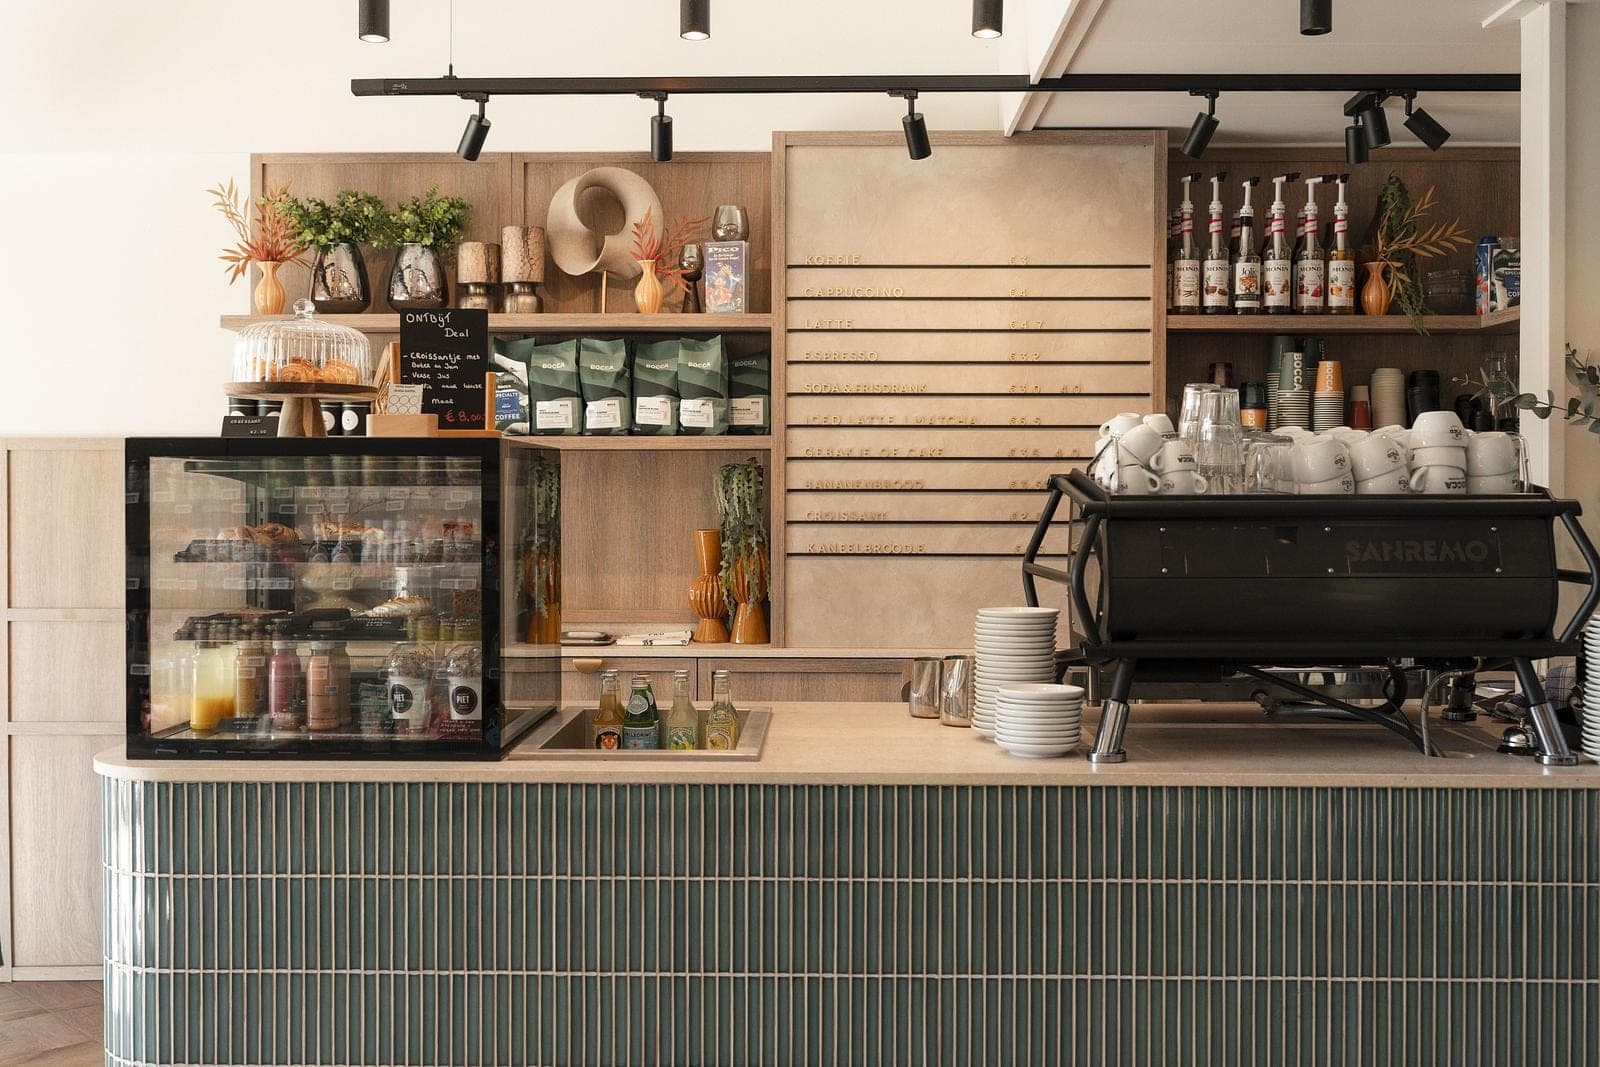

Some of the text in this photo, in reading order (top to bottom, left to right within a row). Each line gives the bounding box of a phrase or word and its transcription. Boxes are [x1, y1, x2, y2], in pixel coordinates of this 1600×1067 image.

[804, 255, 860, 265] KOFFIE
[804, 287, 904, 298] CAPPUCCINO
[804, 319, 853, 330] LATTE
[444, 327, 469, 338] Deal
[804, 351, 879, 361] ESPRESSO
[542, 361, 565, 369] BOCCA
[645, 362, 669, 370] BOCCA
[687, 361, 711, 369] BOCCA
[1293, 353, 1303, 391] BOCCA
[804, 383, 839, 393] SODA
[855, 383, 927, 393] FRISDRANK
[1347, 539, 1489, 562] SANREMO
